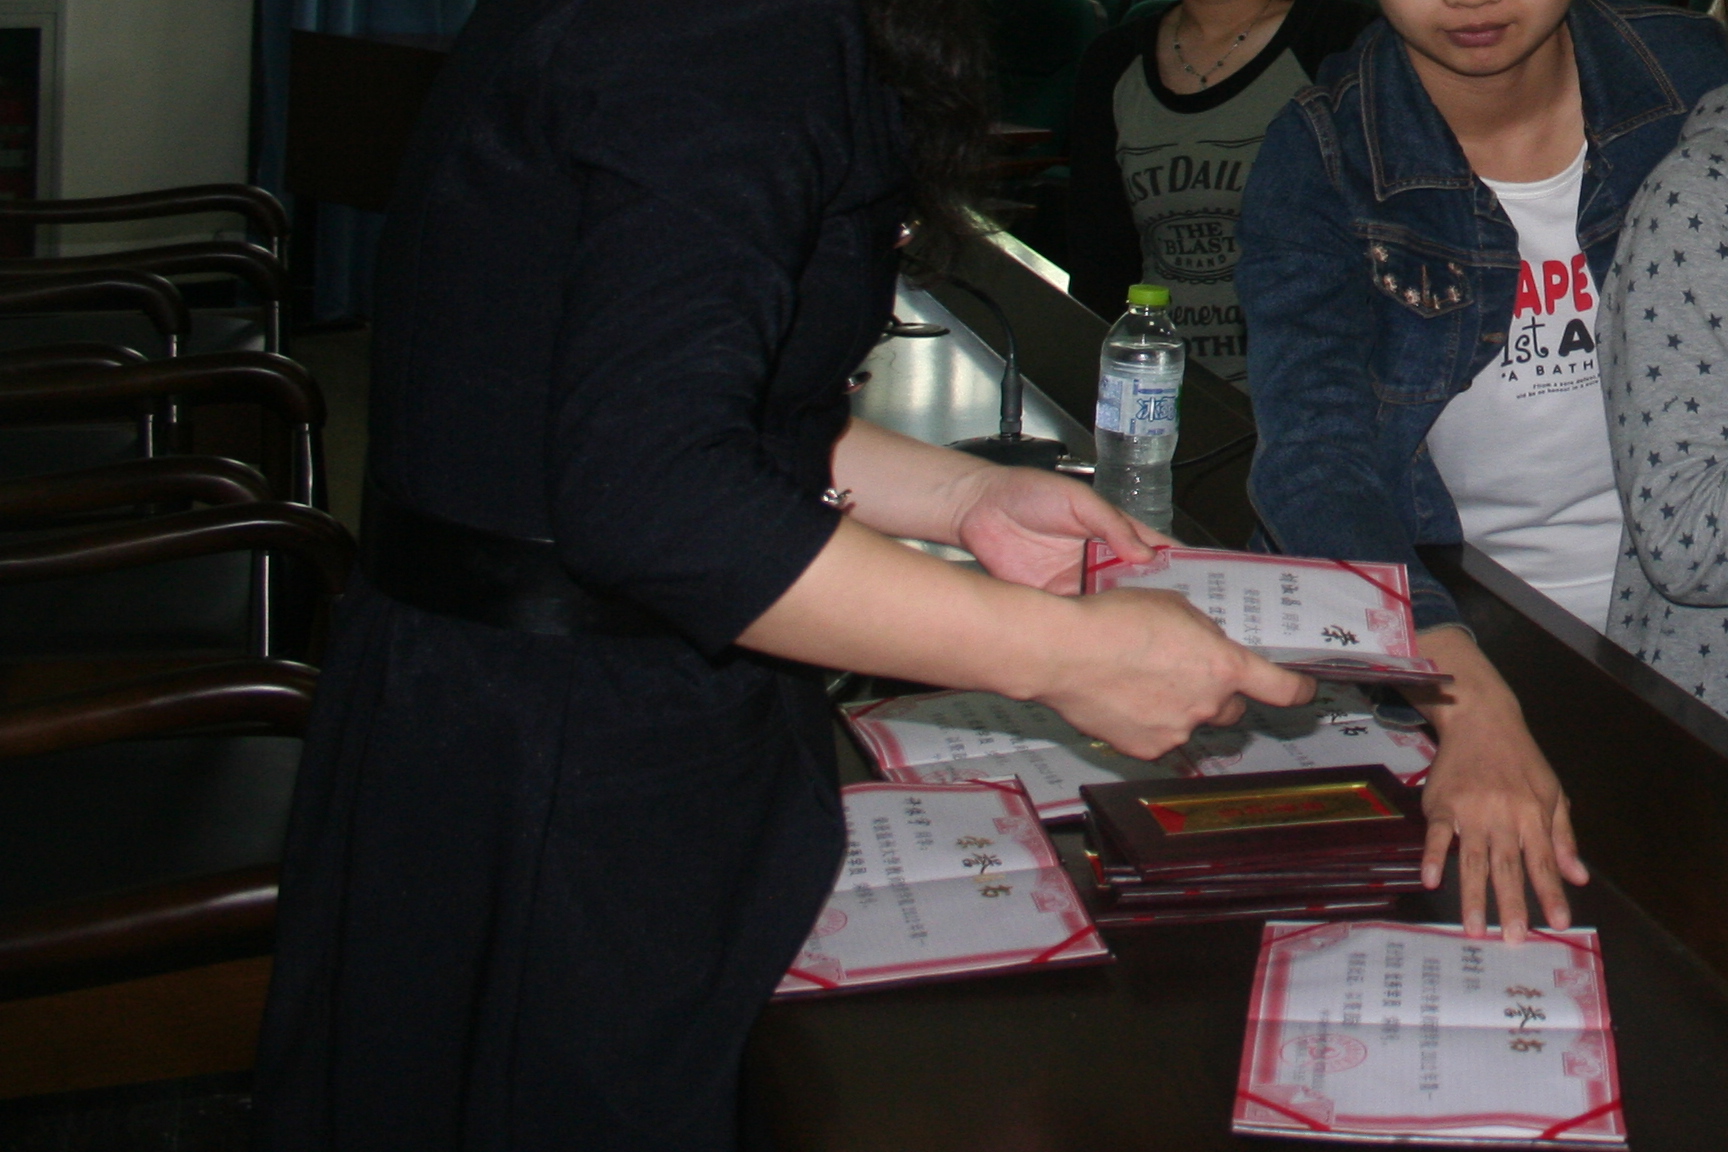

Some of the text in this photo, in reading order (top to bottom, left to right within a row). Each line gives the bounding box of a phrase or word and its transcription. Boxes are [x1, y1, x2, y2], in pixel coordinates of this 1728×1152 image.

[1169, 222, 1223, 239] THE
[1164, 236, 1236, 255] BLAST
[1174, 254, 1228, 268] BRAND
[1169, 305, 1245, 325] enera
[1535, 359, 1594, 377] BATH
